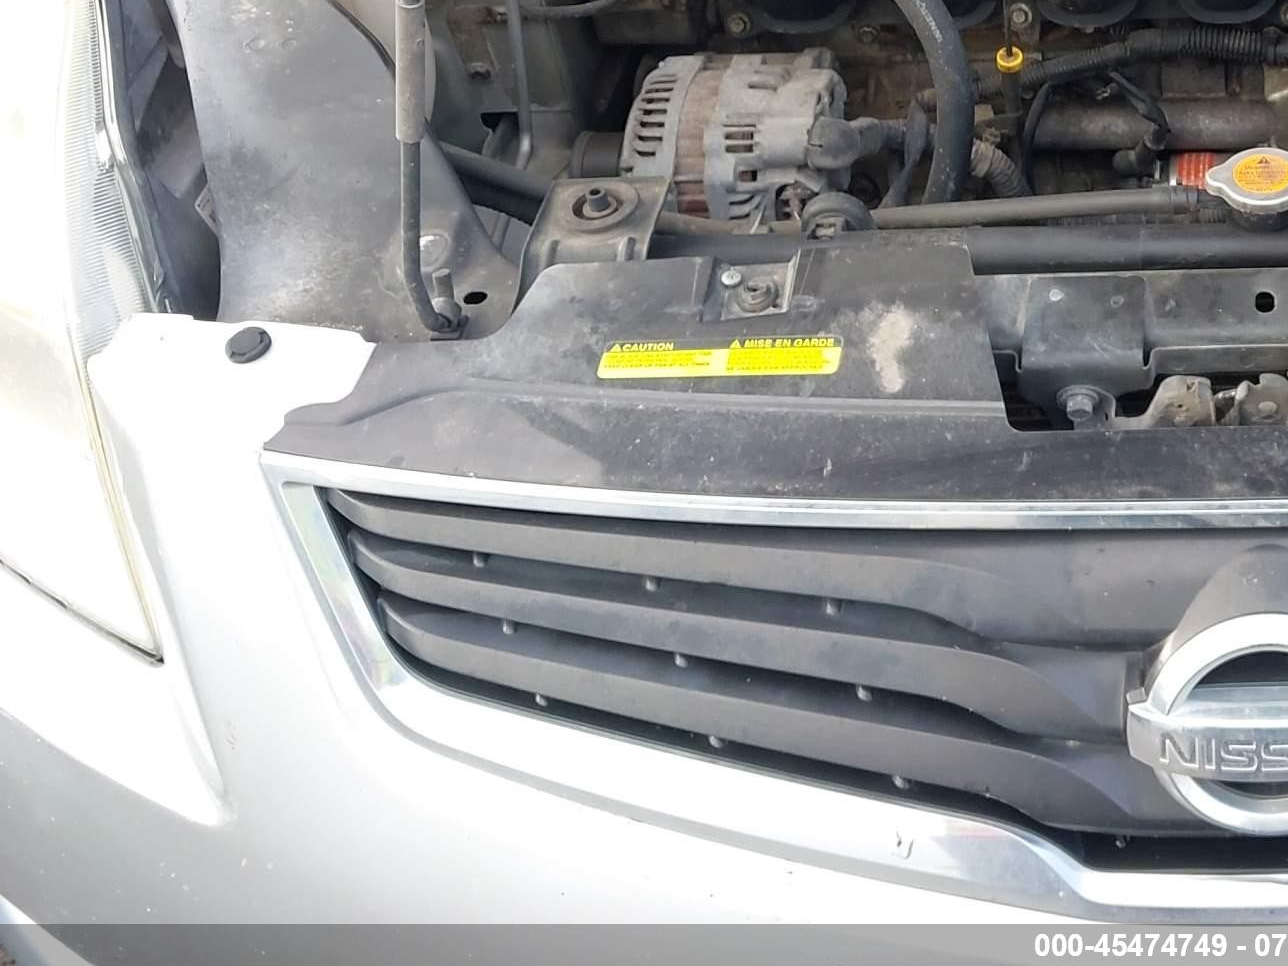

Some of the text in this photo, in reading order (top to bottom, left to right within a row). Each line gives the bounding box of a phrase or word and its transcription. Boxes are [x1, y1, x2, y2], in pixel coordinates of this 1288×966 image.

[622, 342, 675, 352] CAUTION
[743, 337, 835, 348] MISE EN GARDE
